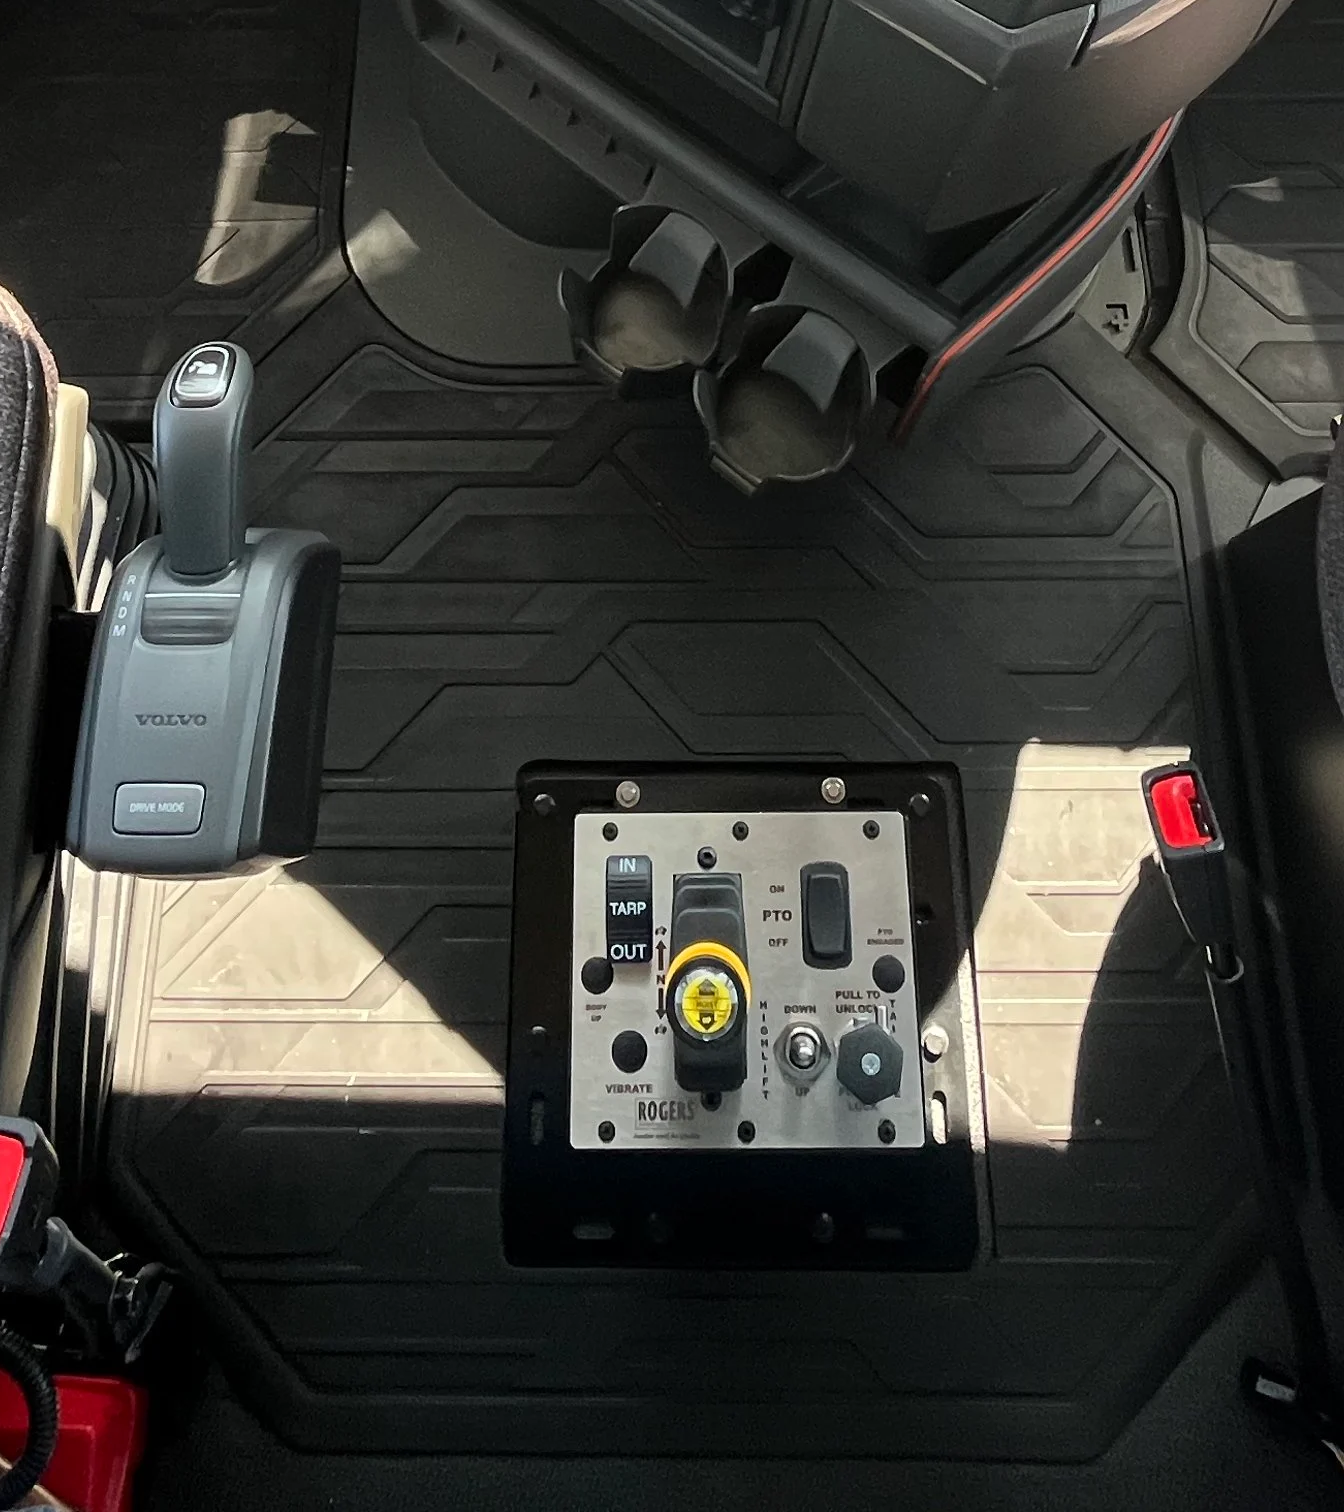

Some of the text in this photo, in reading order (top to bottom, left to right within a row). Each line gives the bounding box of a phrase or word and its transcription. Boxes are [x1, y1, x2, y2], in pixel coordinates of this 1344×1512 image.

[126, 574, 136, 585] R
[122, 590, 132, 602] N
[117, 606, 128, 619] D
[112, 624, 126, 637] M
[134, 713, 207, 726] VOLVO
[129, 801, 185, 813] DRIVE MODE
[619, 857, 637, 873] IN
[769, 885, 785, 894] ON
[609, 901, 647, 916] TARP
[762, 909, 793, 922] PTO
[768, 938, 789, 947] OFF
[610, 944, 648, 960] OUT
[835, 990, 881, 999] PULL TO
[783, 1004, 817, 1014] DOWN
[606, 1084, 653, 1094] VIBRATE
[795, 1087, 810, 1096] UP
[638, 1099, 694, 1122] ROGERS
